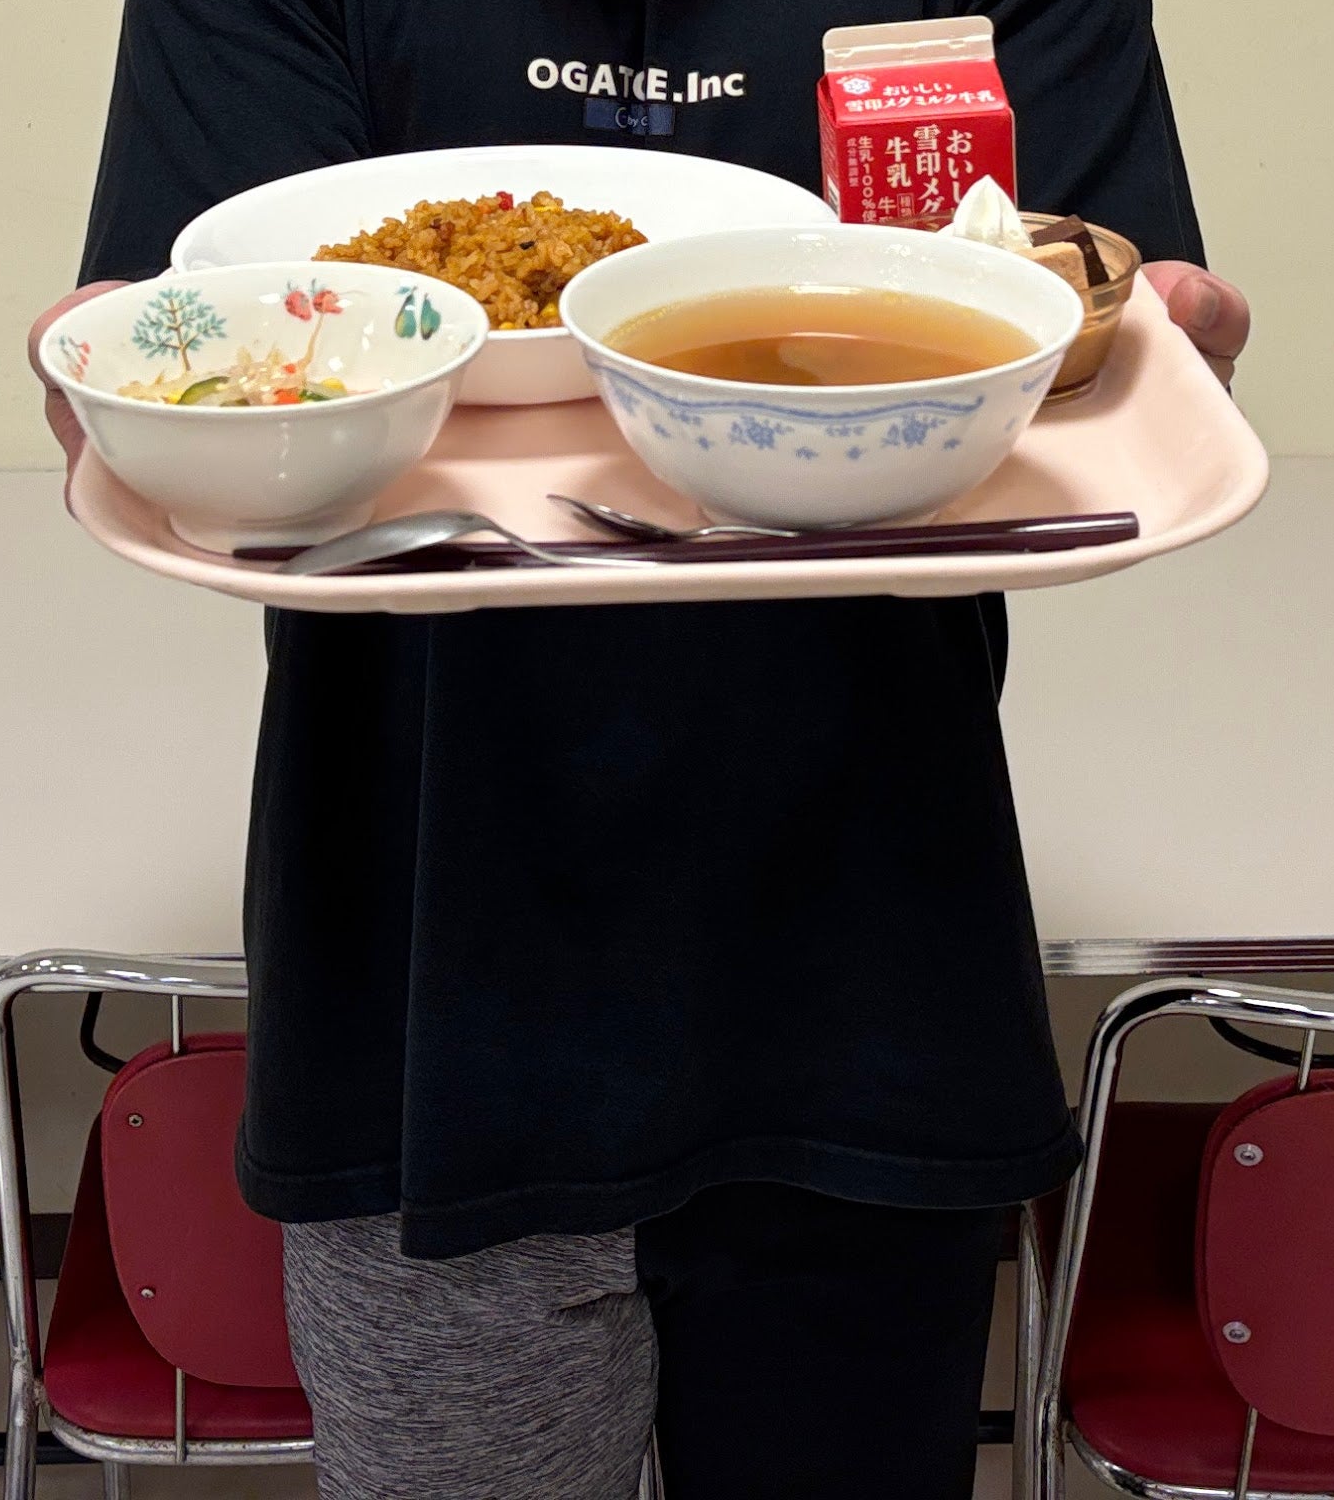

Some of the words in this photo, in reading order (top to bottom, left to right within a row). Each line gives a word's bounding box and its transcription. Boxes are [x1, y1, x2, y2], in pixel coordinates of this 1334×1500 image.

[845, 90, 996, 113] 雪印メグミルク牛乳
[882, 83, 953, 97] おいしい
[884, 136, 912, 189] 牛乳
[946, 129, 974, 212] おいし
